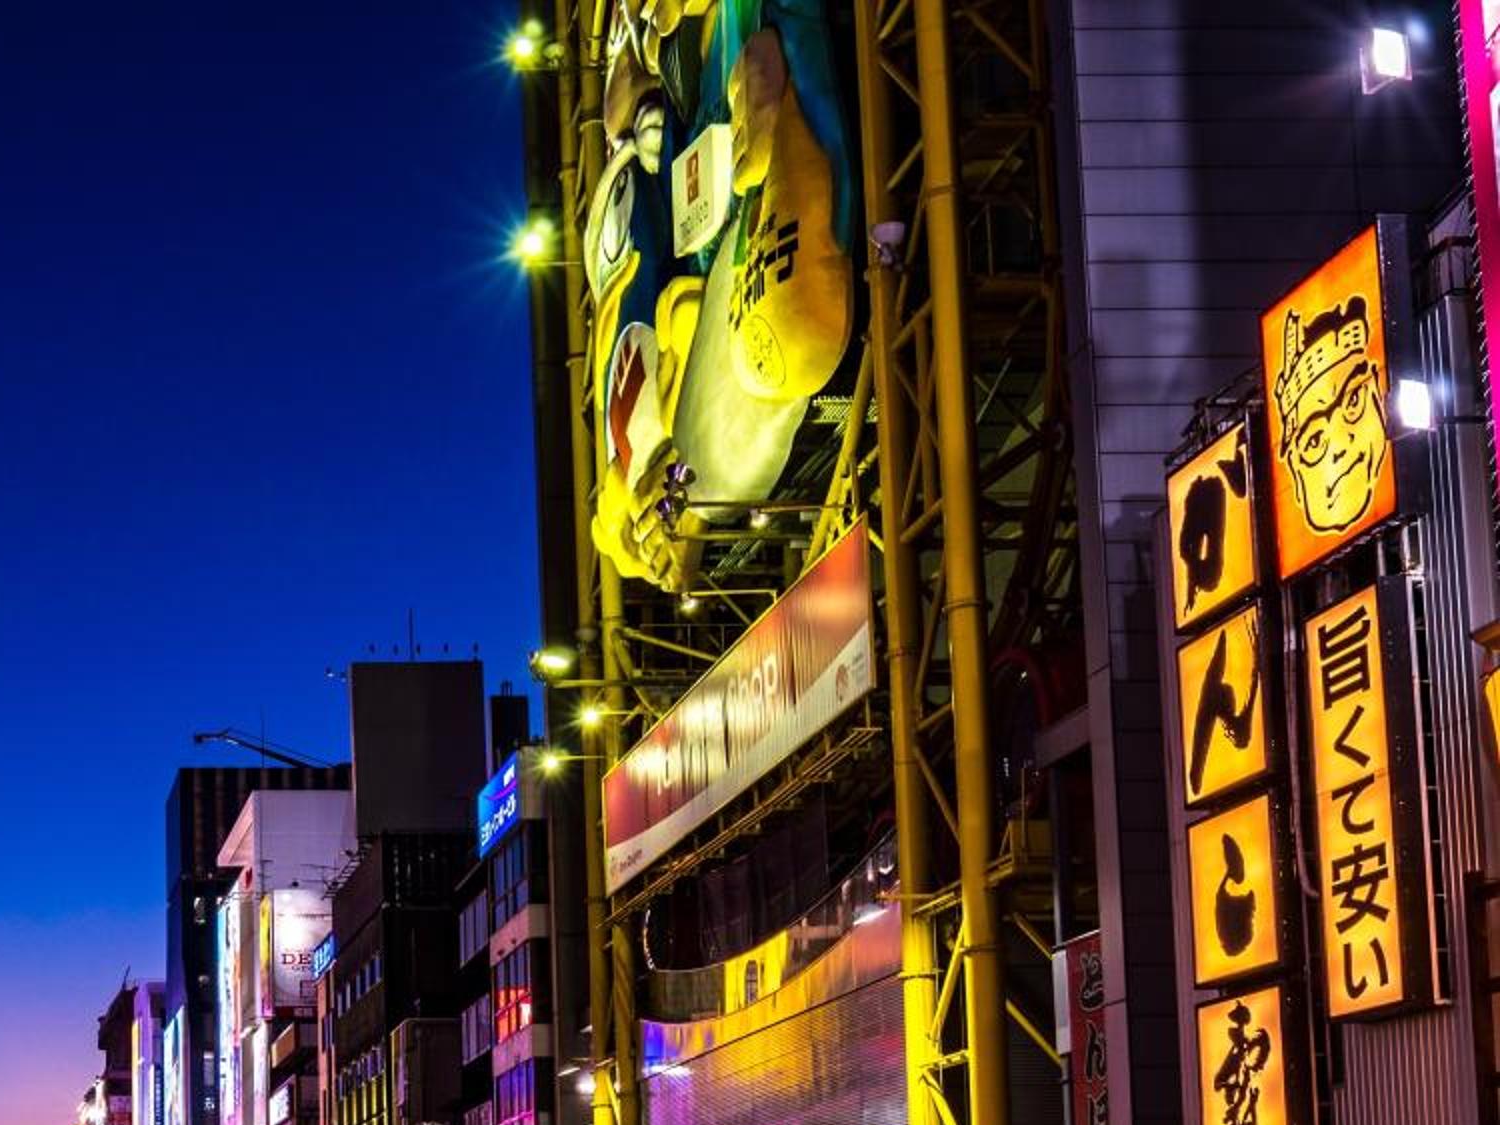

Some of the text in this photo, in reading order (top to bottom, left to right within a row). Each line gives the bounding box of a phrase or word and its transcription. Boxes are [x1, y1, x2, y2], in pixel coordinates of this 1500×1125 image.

[1319, 603, 1390, 999] 旨くて安い
